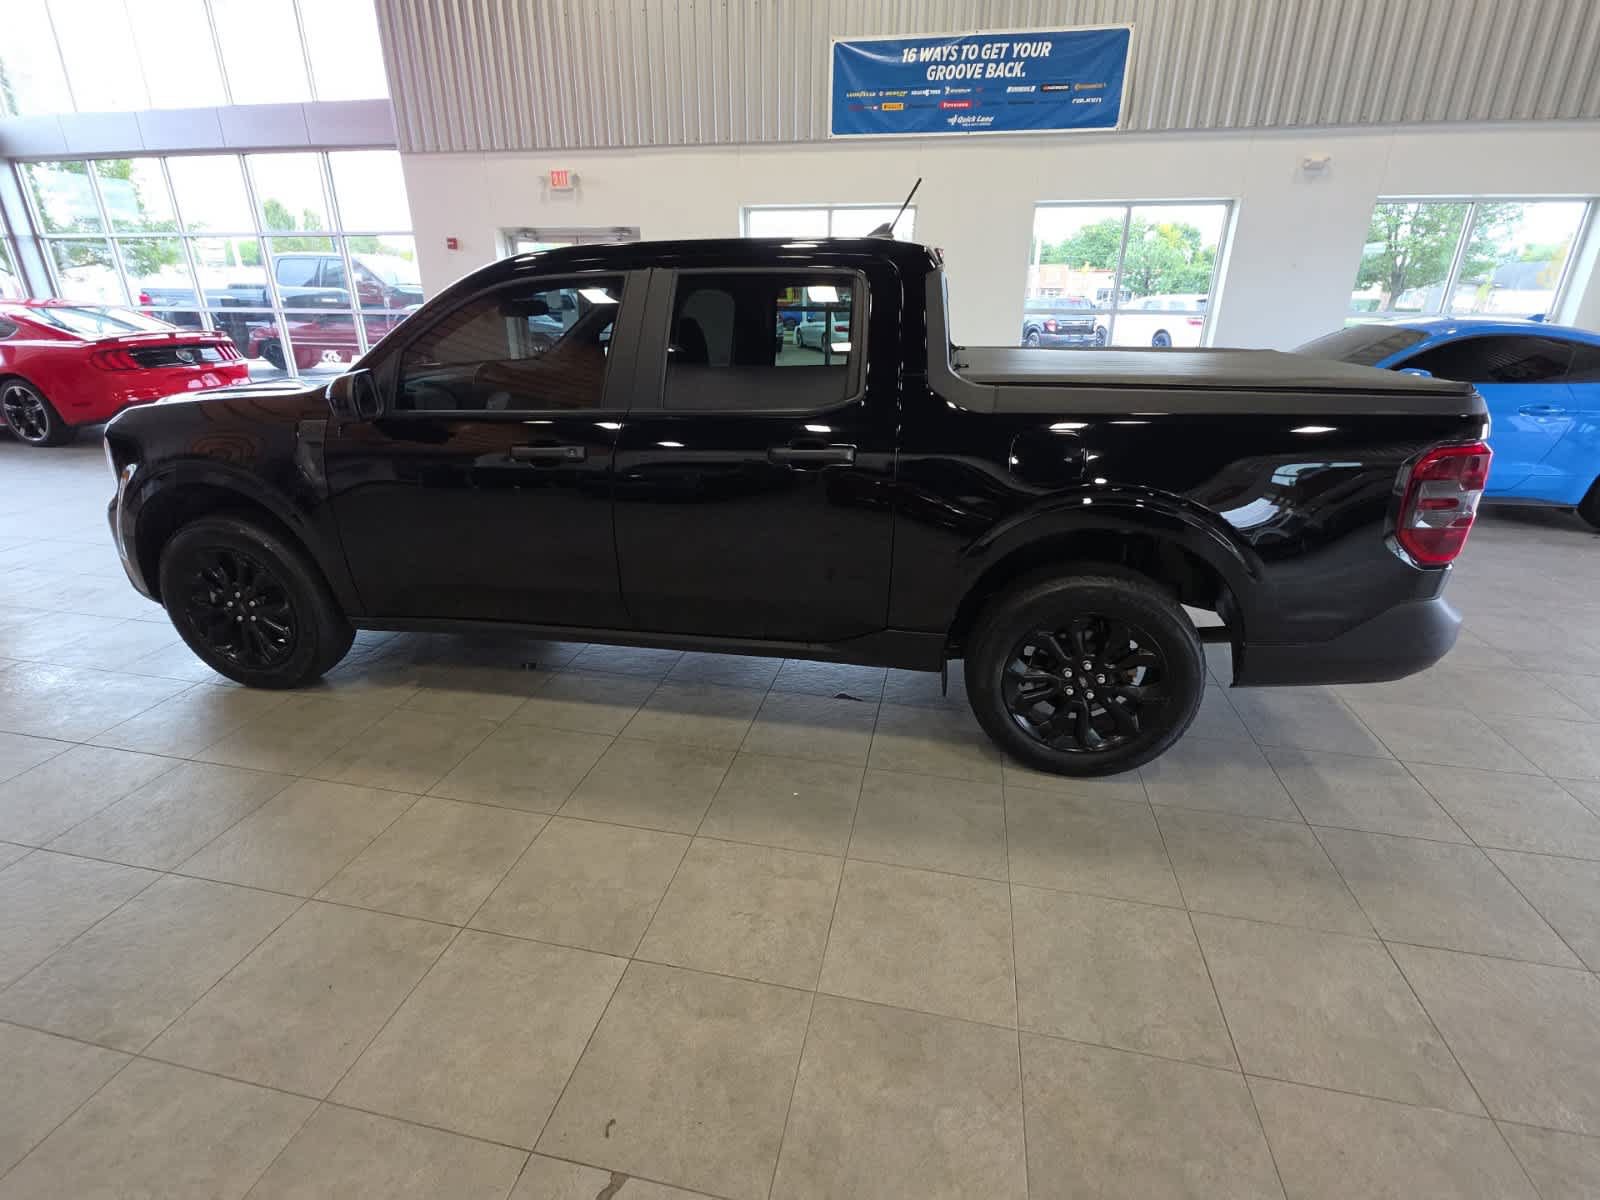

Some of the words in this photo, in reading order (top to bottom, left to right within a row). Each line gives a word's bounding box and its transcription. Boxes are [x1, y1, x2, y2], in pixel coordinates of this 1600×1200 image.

[902, 47, 916, 63] 16
[919, 45, 958, 62] WAYS
[961, 44, 978, 61] TO
[981, 42, 1009, 60] GET
[1012, 41, 1052, 58] YOUR
[926, 63, 984, 81] GROOVE
[985, 61, 1026, 79] BACK.
[957, 115, 976, 124] Quick
